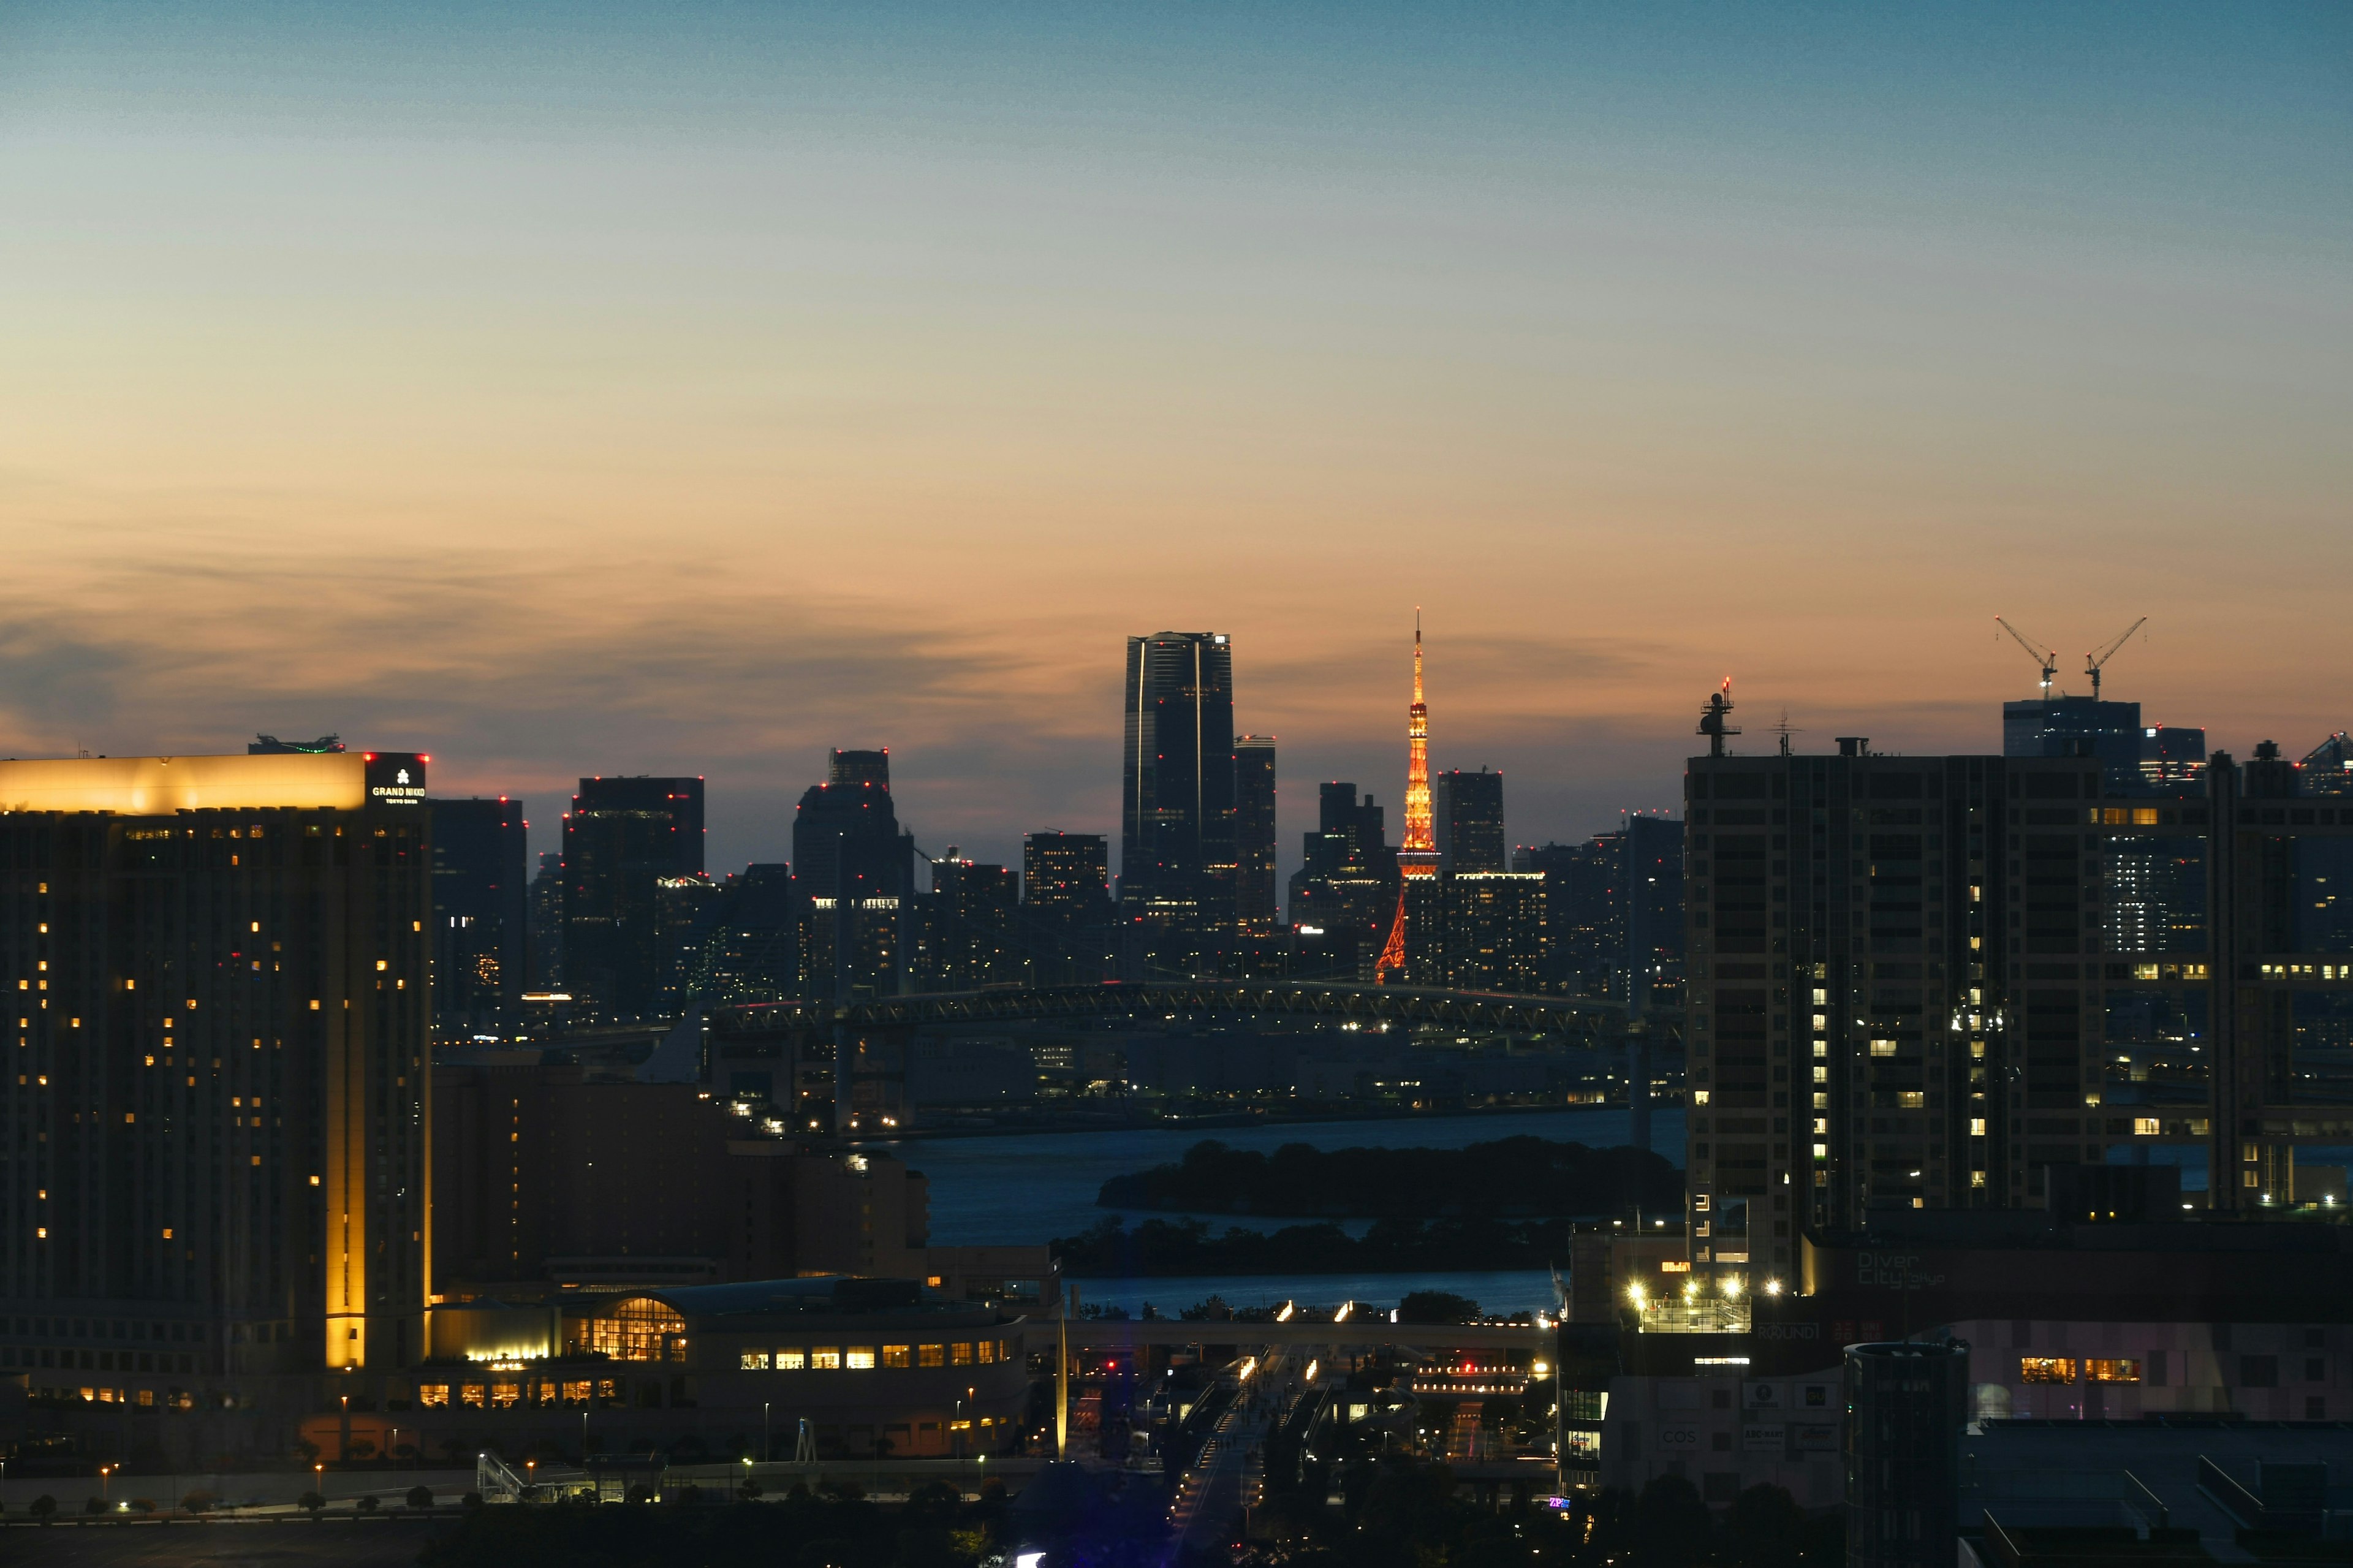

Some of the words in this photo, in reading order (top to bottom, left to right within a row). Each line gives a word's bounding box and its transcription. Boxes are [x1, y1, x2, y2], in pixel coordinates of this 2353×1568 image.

[373, 787, 404, 796] GRAND
[406, 788, 425, 797] NIKKO
[1858, 1252, 1920, 1268] Diver
[1858, 1269, 1902, 1290] City
[1807, 1392, 1824, 1401] GU
[1662, 1431, 1697, 1443] COS
[1745, 1430, 1784, 1438] ABC-MART
